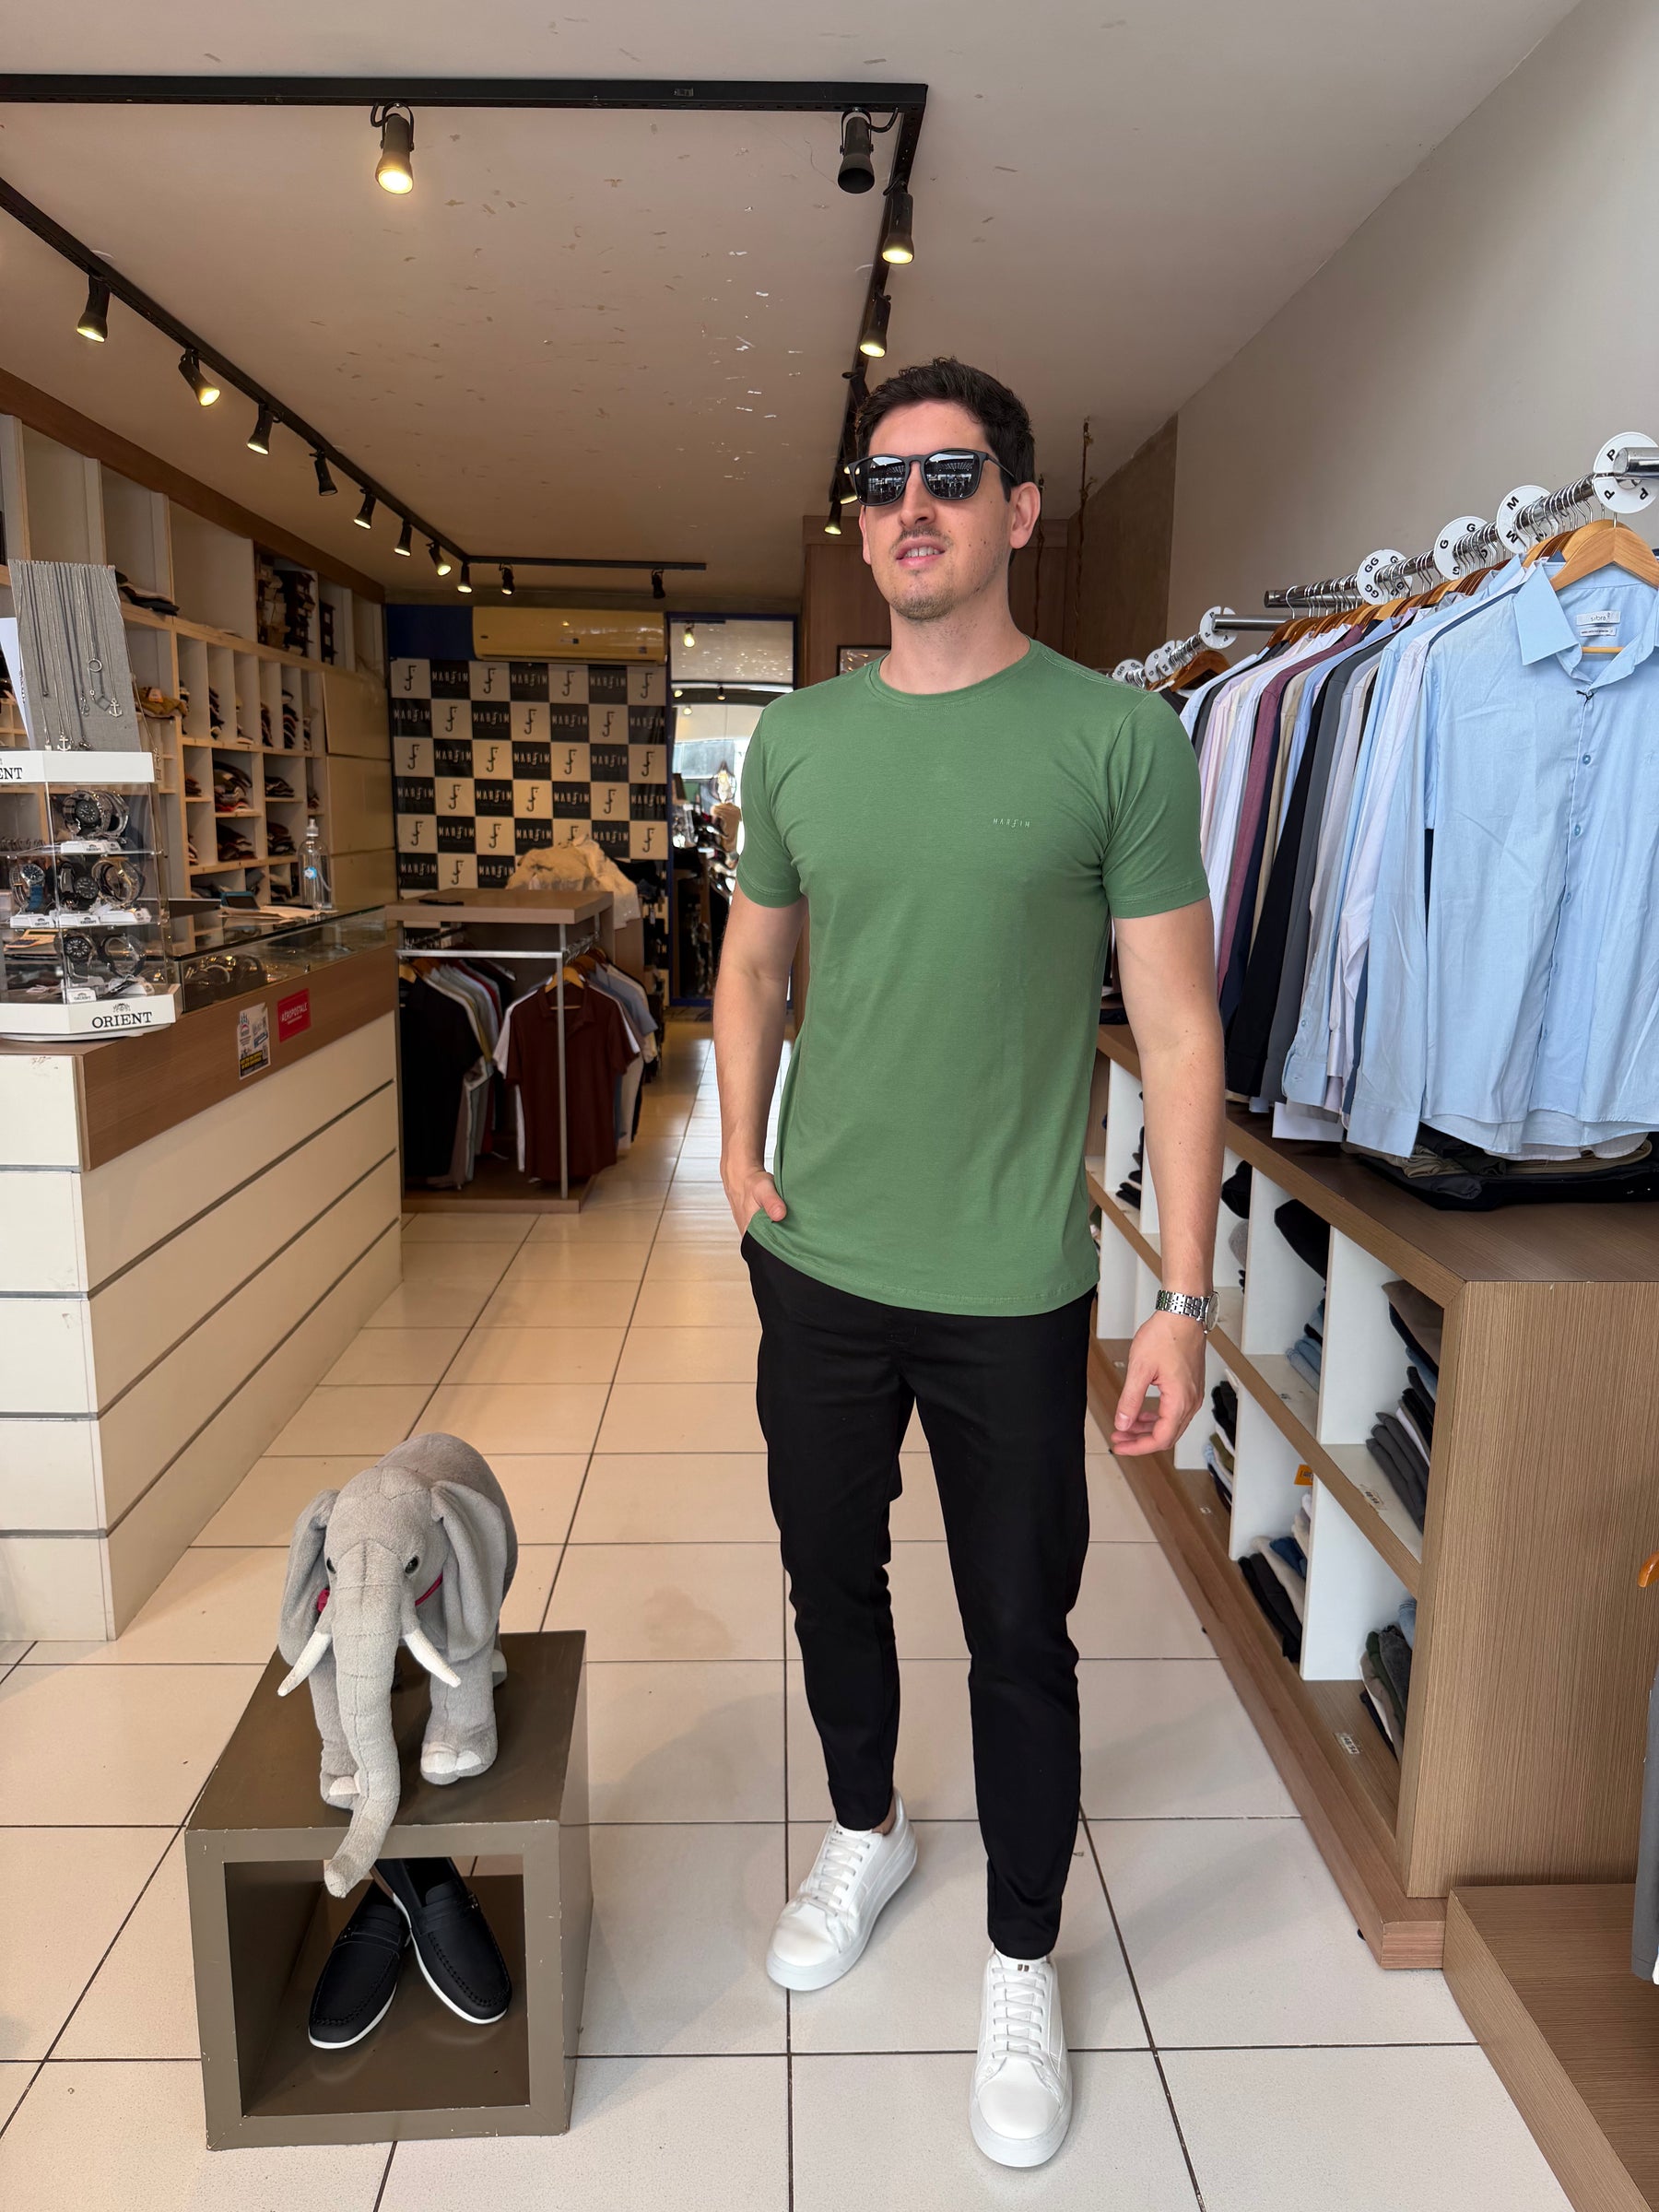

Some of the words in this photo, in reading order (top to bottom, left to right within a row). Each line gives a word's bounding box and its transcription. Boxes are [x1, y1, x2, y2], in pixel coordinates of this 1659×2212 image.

[1606, 449, 1618, 462] P
[1604, 489, 1616, 500] P
[1639, 487, 1649, 500] P
[1506, 496, 1520, 511] M
[1466, 523, 1476, 532] G
[1440, 539, 1449, 548] G
[1506, 530, 1519, 544] M
[1364, 557, 1380, 573] GG
[1364, 583, 1380, 598] GG
[92, 1011, 153, 1029] ORIENT
